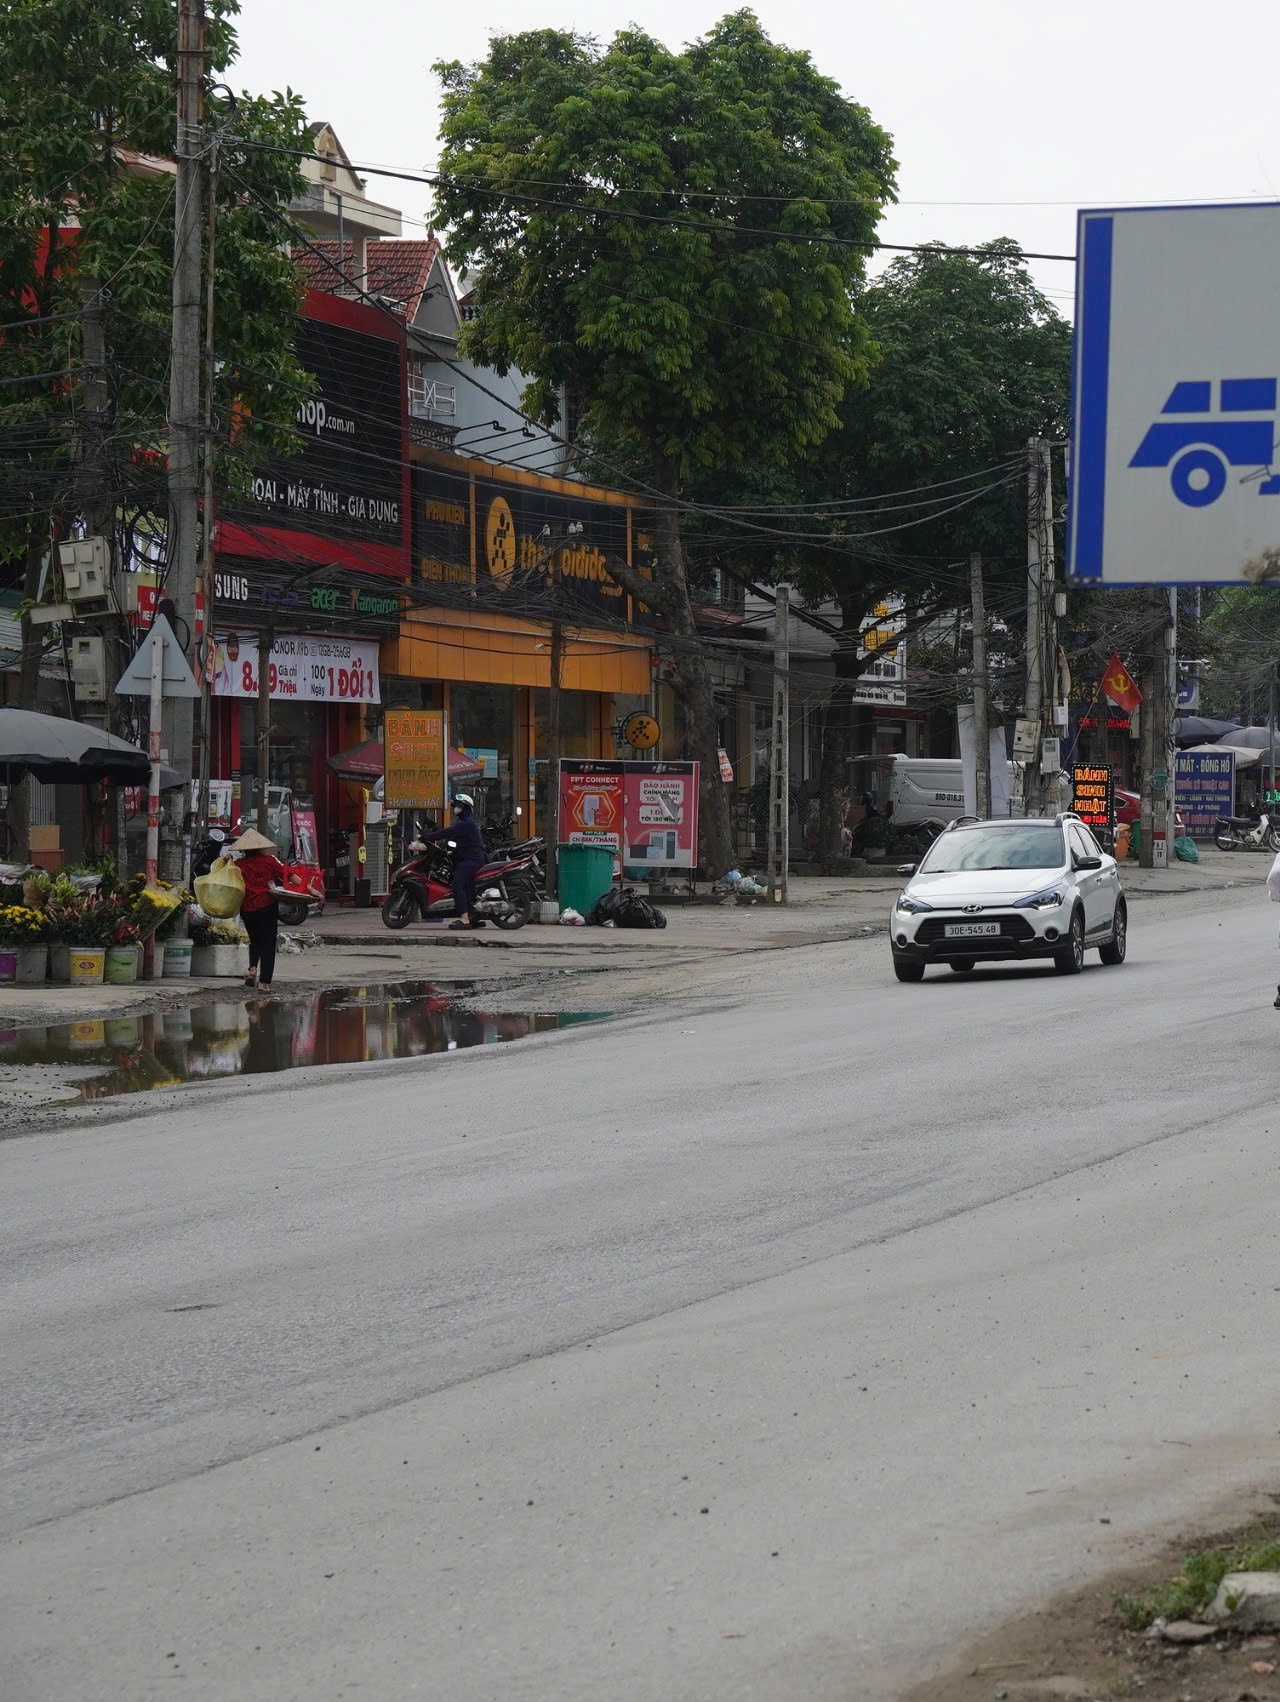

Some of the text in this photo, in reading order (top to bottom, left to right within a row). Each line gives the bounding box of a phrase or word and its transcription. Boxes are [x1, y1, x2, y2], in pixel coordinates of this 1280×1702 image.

[287, 479, 311, 509] MÁY
[313, 483, 339, 514] TÍNH
[347, 495, 367, 519] GIA
[369, 500, 398, 529] DỤNG
[215, 573, 248, 601] SUNG
[310, 587, 339, 611] acer
[311, 665, 325, 679] 100
[328, 658, 373, 698] 1 ĐỔI 1
[278, 680, 297, 697] Triệu
[311, 684, 326, 697] Ngày
[388, 712, 440, 738] BÁNH
[585, 776, 620, 784] CONNECT
[1074, 768, 1108, 782] BÁNH
[644, 780, 658, 788] BẢO
[1076, 784, 1106, 797] SINH
[1074, 798, 1107, 814] NHẬT
[949, 925, 996, 936] 30E-545.48
